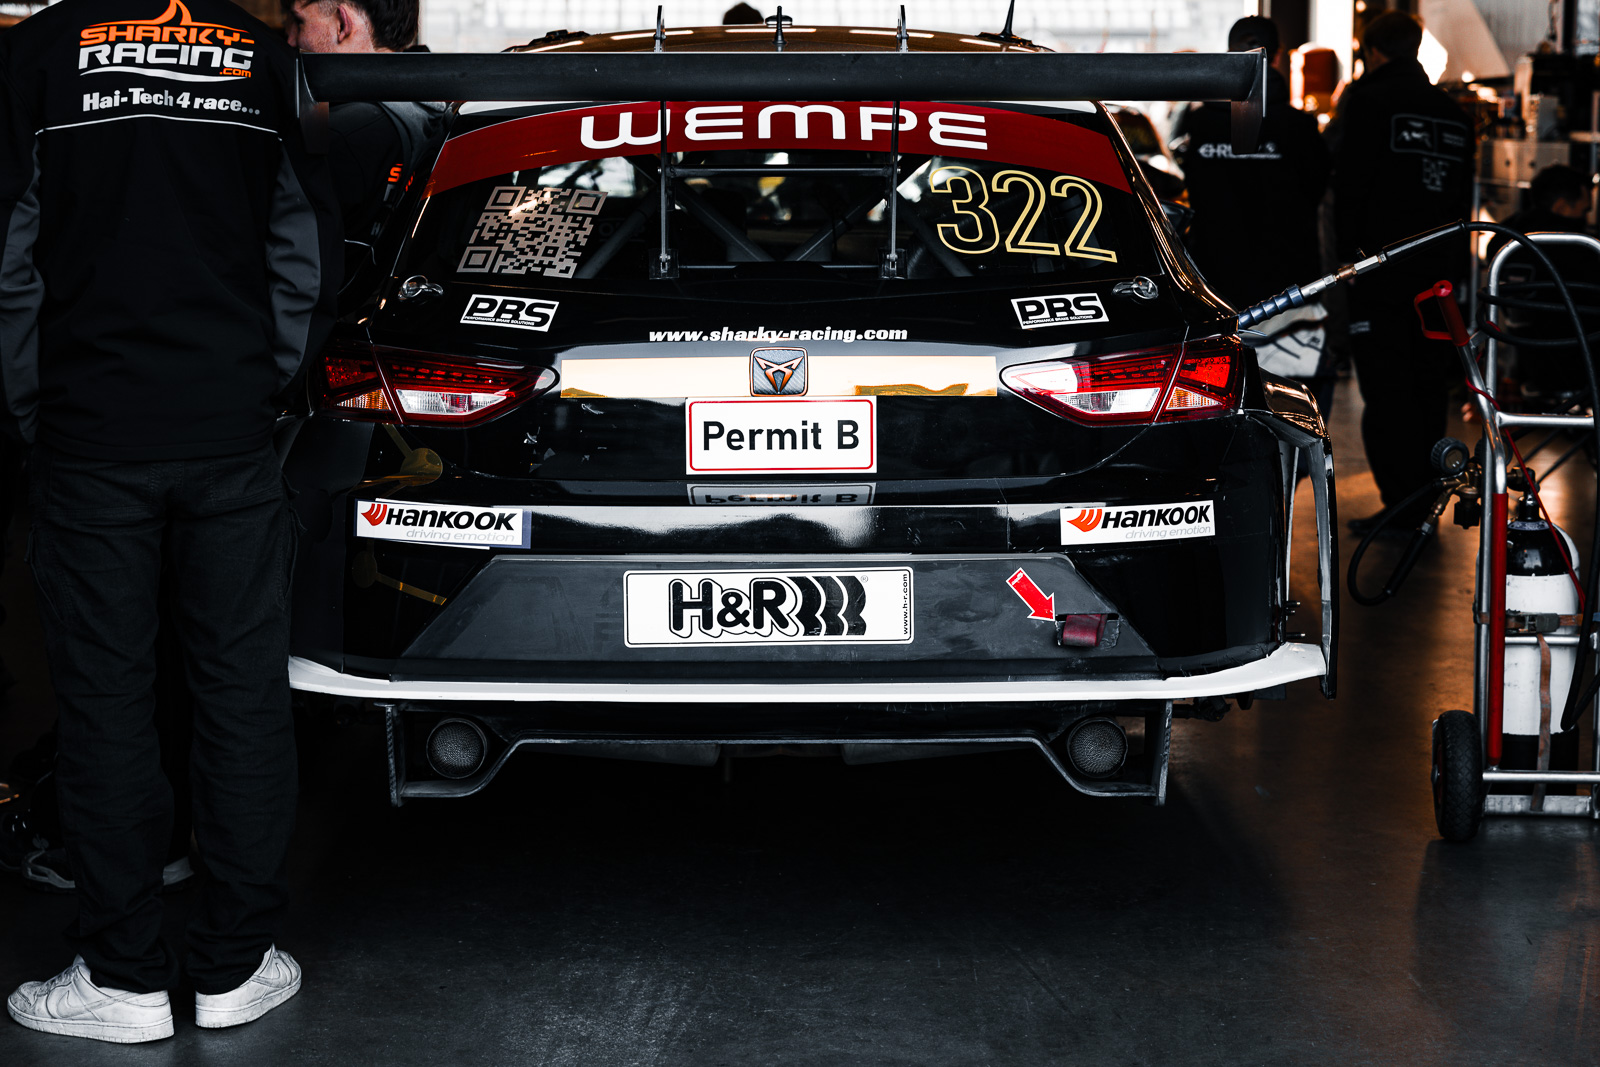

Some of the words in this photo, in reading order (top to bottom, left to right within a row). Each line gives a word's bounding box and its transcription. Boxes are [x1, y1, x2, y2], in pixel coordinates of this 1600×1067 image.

[79, 25, 255, 46] SHARKY-
[78, 43, 254, 70] RACING
[219, 67, 252, 78] .com
[82, 87, 174, 112] Hai-Tech
[176, 92, 191, 109] 4
[193, 97, 261, 116] race...
[580, 104, 988, 150] WEMPE
[929, 166, 1118, 263] 322
[649, 326, 908, 343] www.sharky-racing.com
[703, 420, 822, 451] Permit
[837, 419, 860, 450] B
[406, 528, 450, 541] driving
[453, 531, 515, 542] emotion
[1125, 529, 1167, 540] driving
[1169, 525, 1211, 537] emotion
[669, 577, 799, 638] H&R
